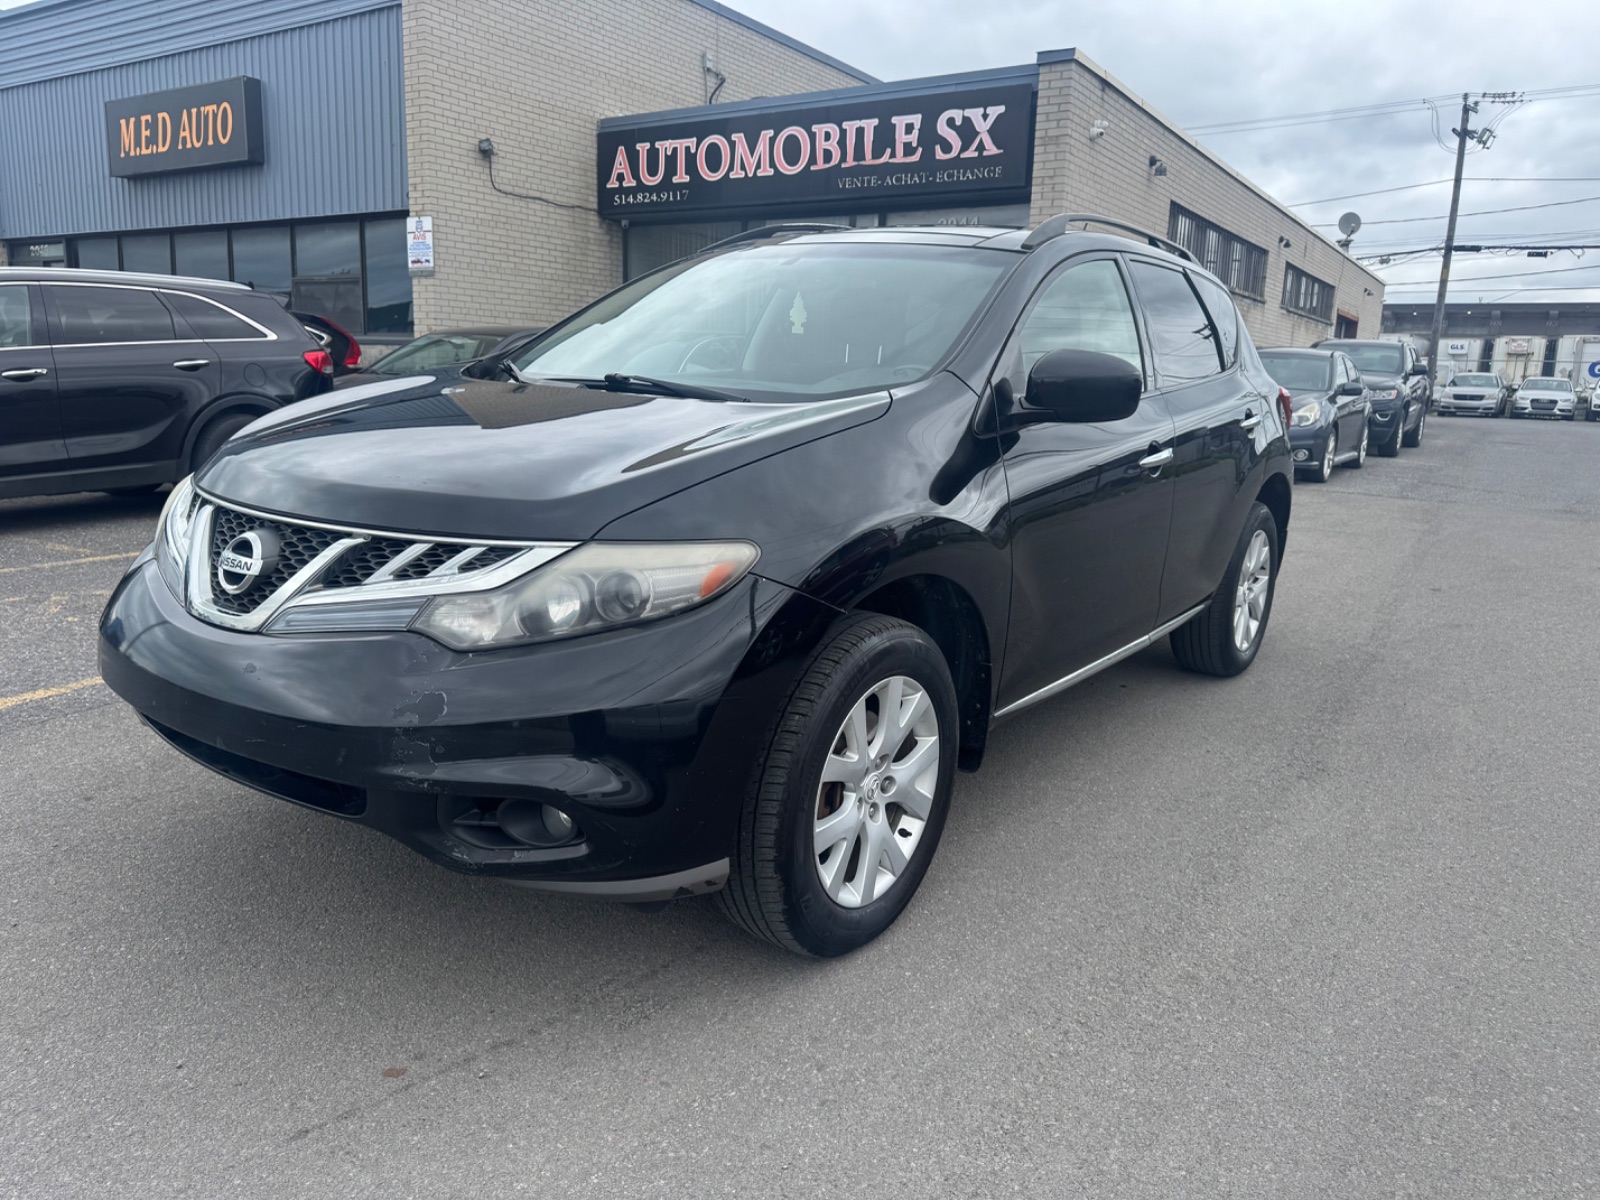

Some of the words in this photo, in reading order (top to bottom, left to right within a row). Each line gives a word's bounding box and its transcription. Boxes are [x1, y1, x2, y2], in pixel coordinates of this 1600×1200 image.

[119, 111, 171, 158] M.E.D
[178, 102, 233, 149] AUTO
[606, 113, 922, 188] AUTOMOBILE
[935, 105, 1005, 160] SX
[936, 166, 1002, 183] ECHANGE
[613, 190, 689, 206] 514.824.9117
[219, 555, 253, 572] NISSAN
